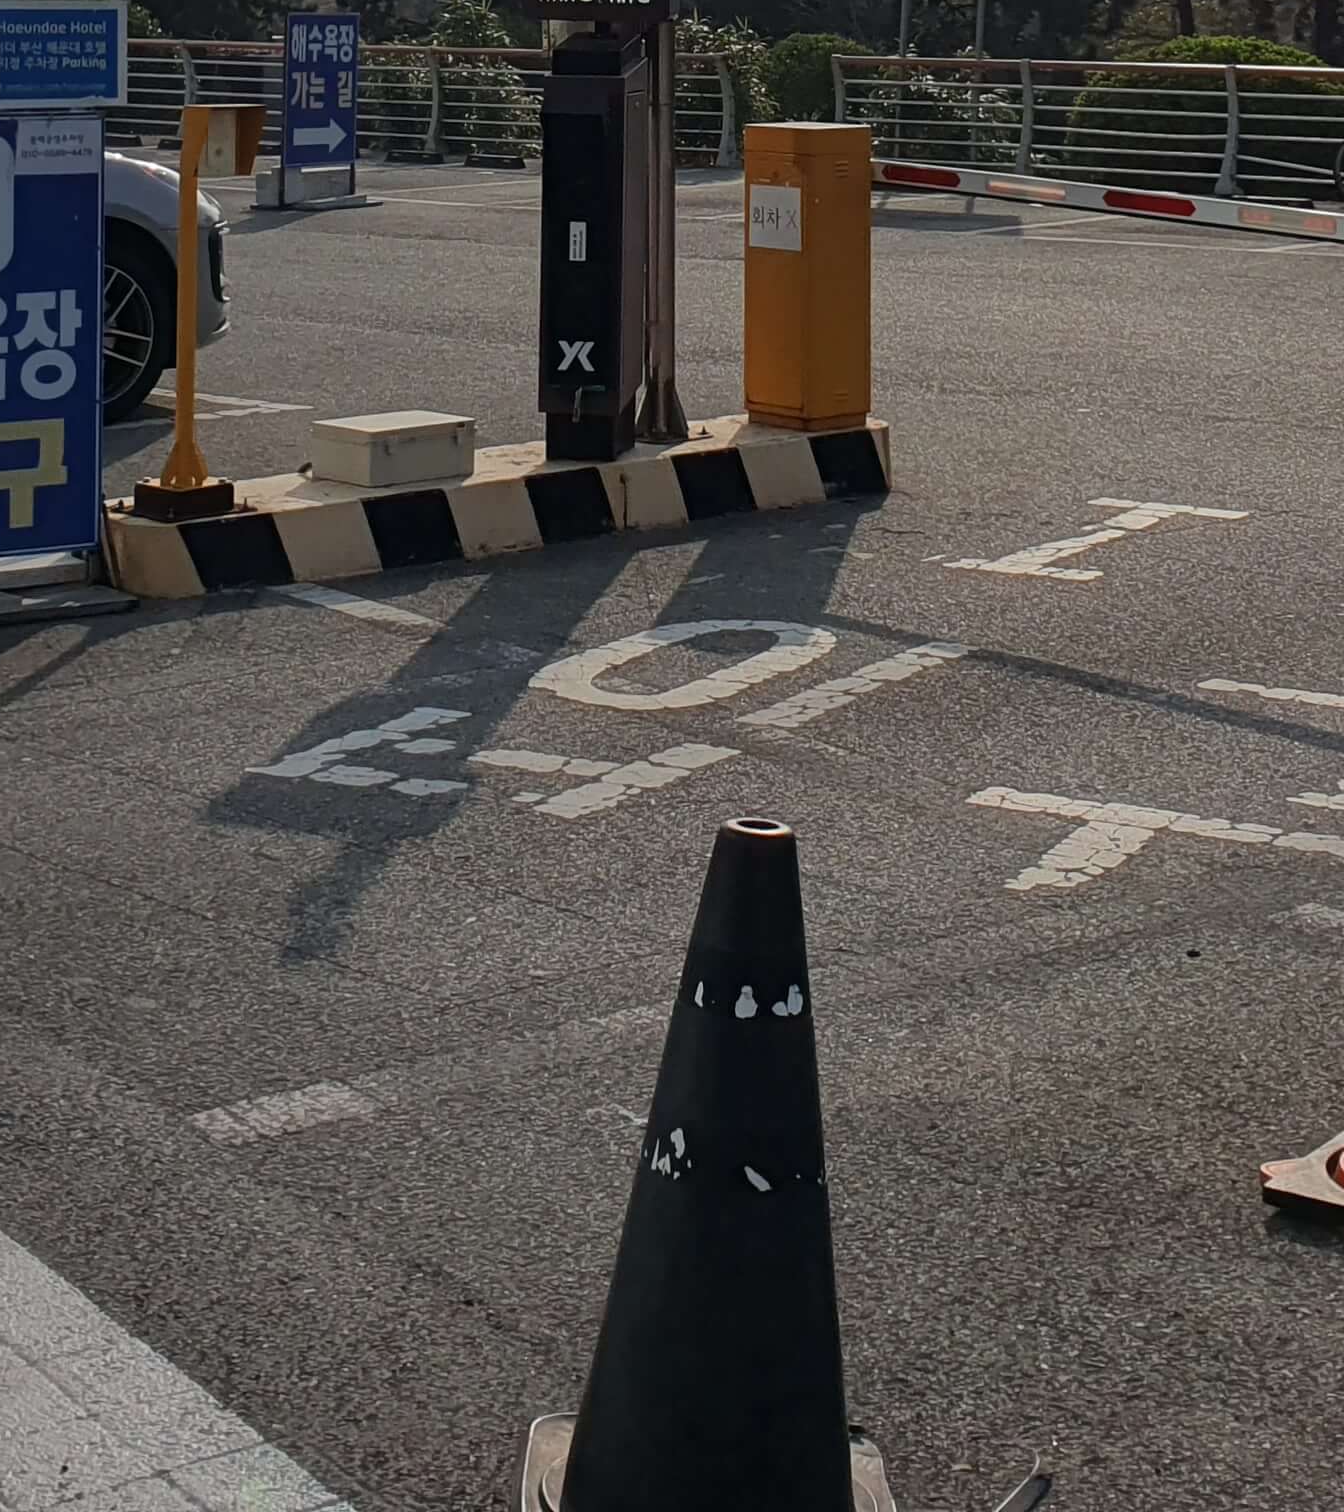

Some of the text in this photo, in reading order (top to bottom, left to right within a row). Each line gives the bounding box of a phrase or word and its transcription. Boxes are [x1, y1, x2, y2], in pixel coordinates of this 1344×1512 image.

[71, 20, 107, 34] Hotel
[290, 24, 355, 63] 해수욕장
[62, 56, 107, 71] Parking
[290, 71, 354, 109] 가는 길
[752, 205, 782, 231] 회차
